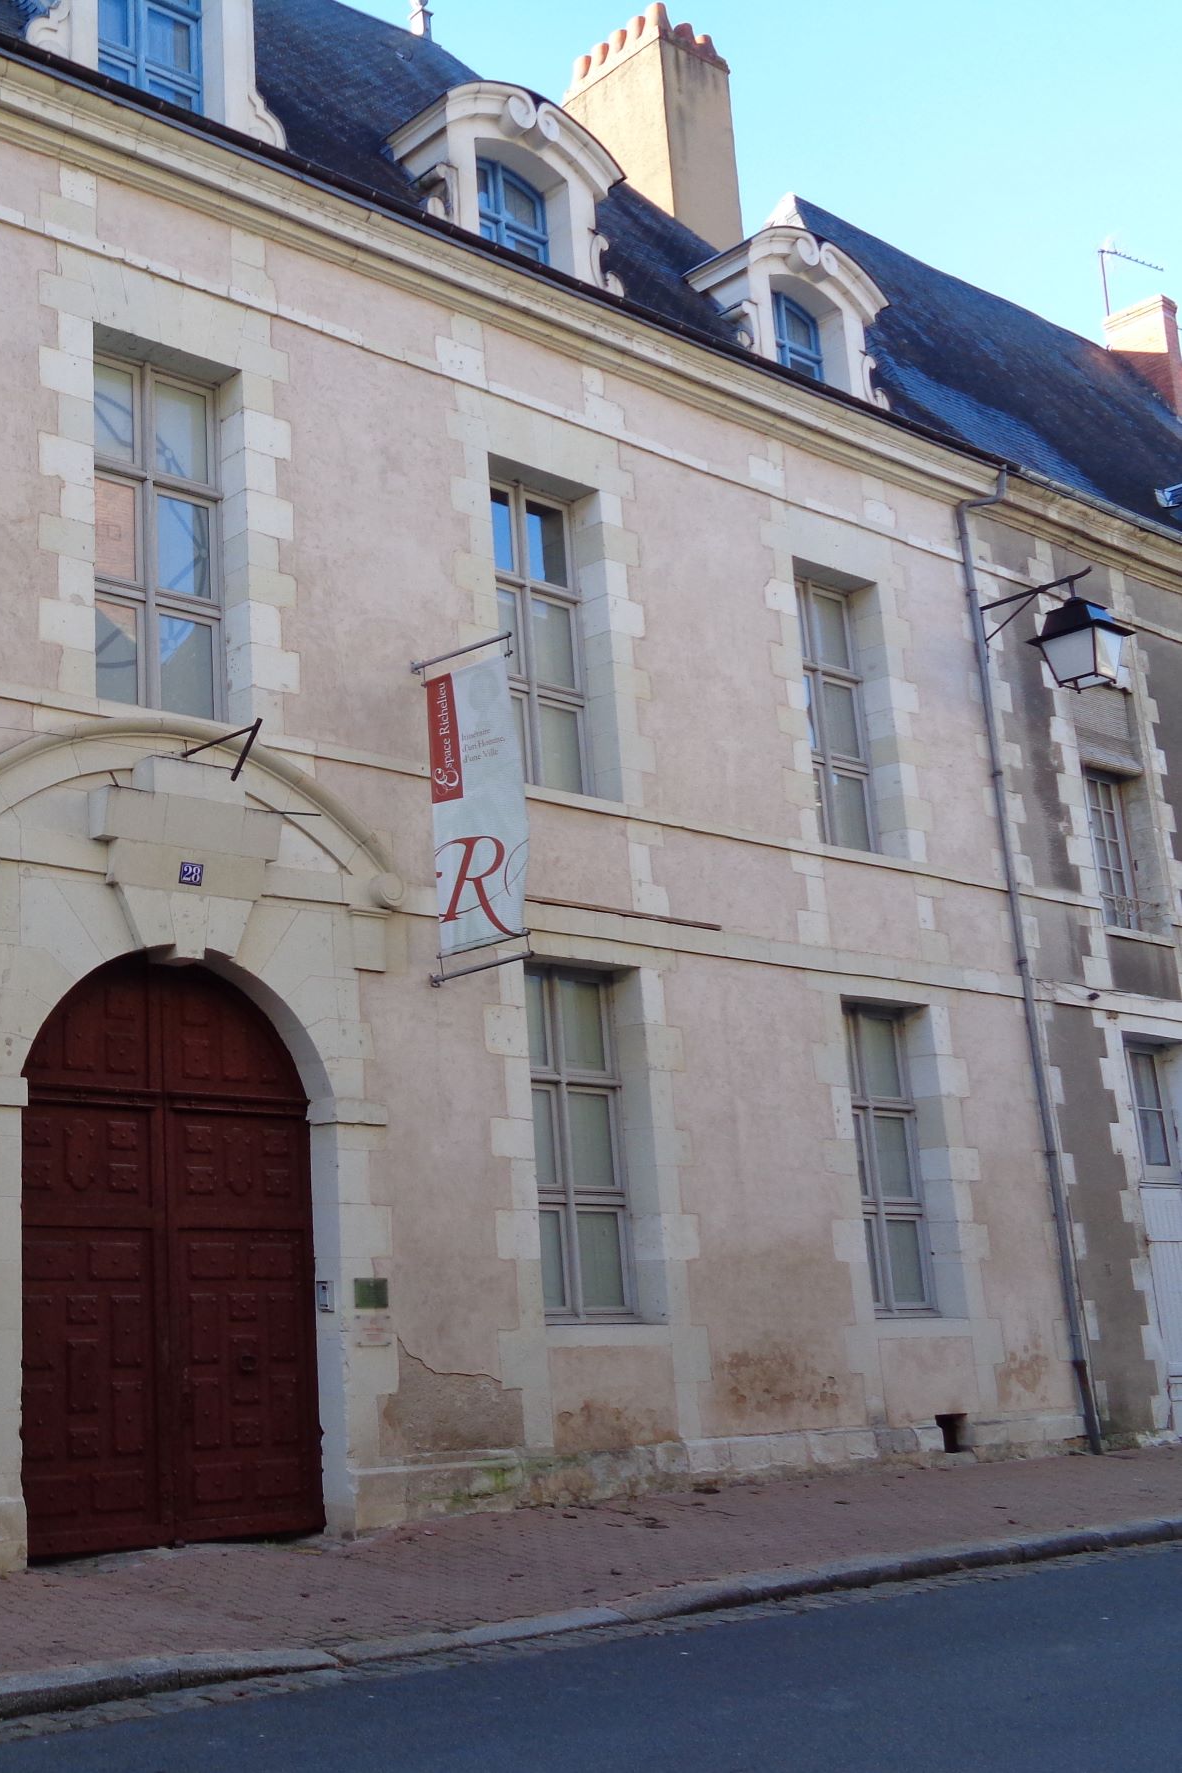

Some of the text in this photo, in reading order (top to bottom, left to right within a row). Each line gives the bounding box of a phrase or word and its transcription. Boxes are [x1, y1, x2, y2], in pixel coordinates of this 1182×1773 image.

[434, 682, 459, 795] Espace Richelieu
[482, 747, 499, 758] Ville
[183, 865, 201, 883] 28
[434, 835, 522, 937] R
